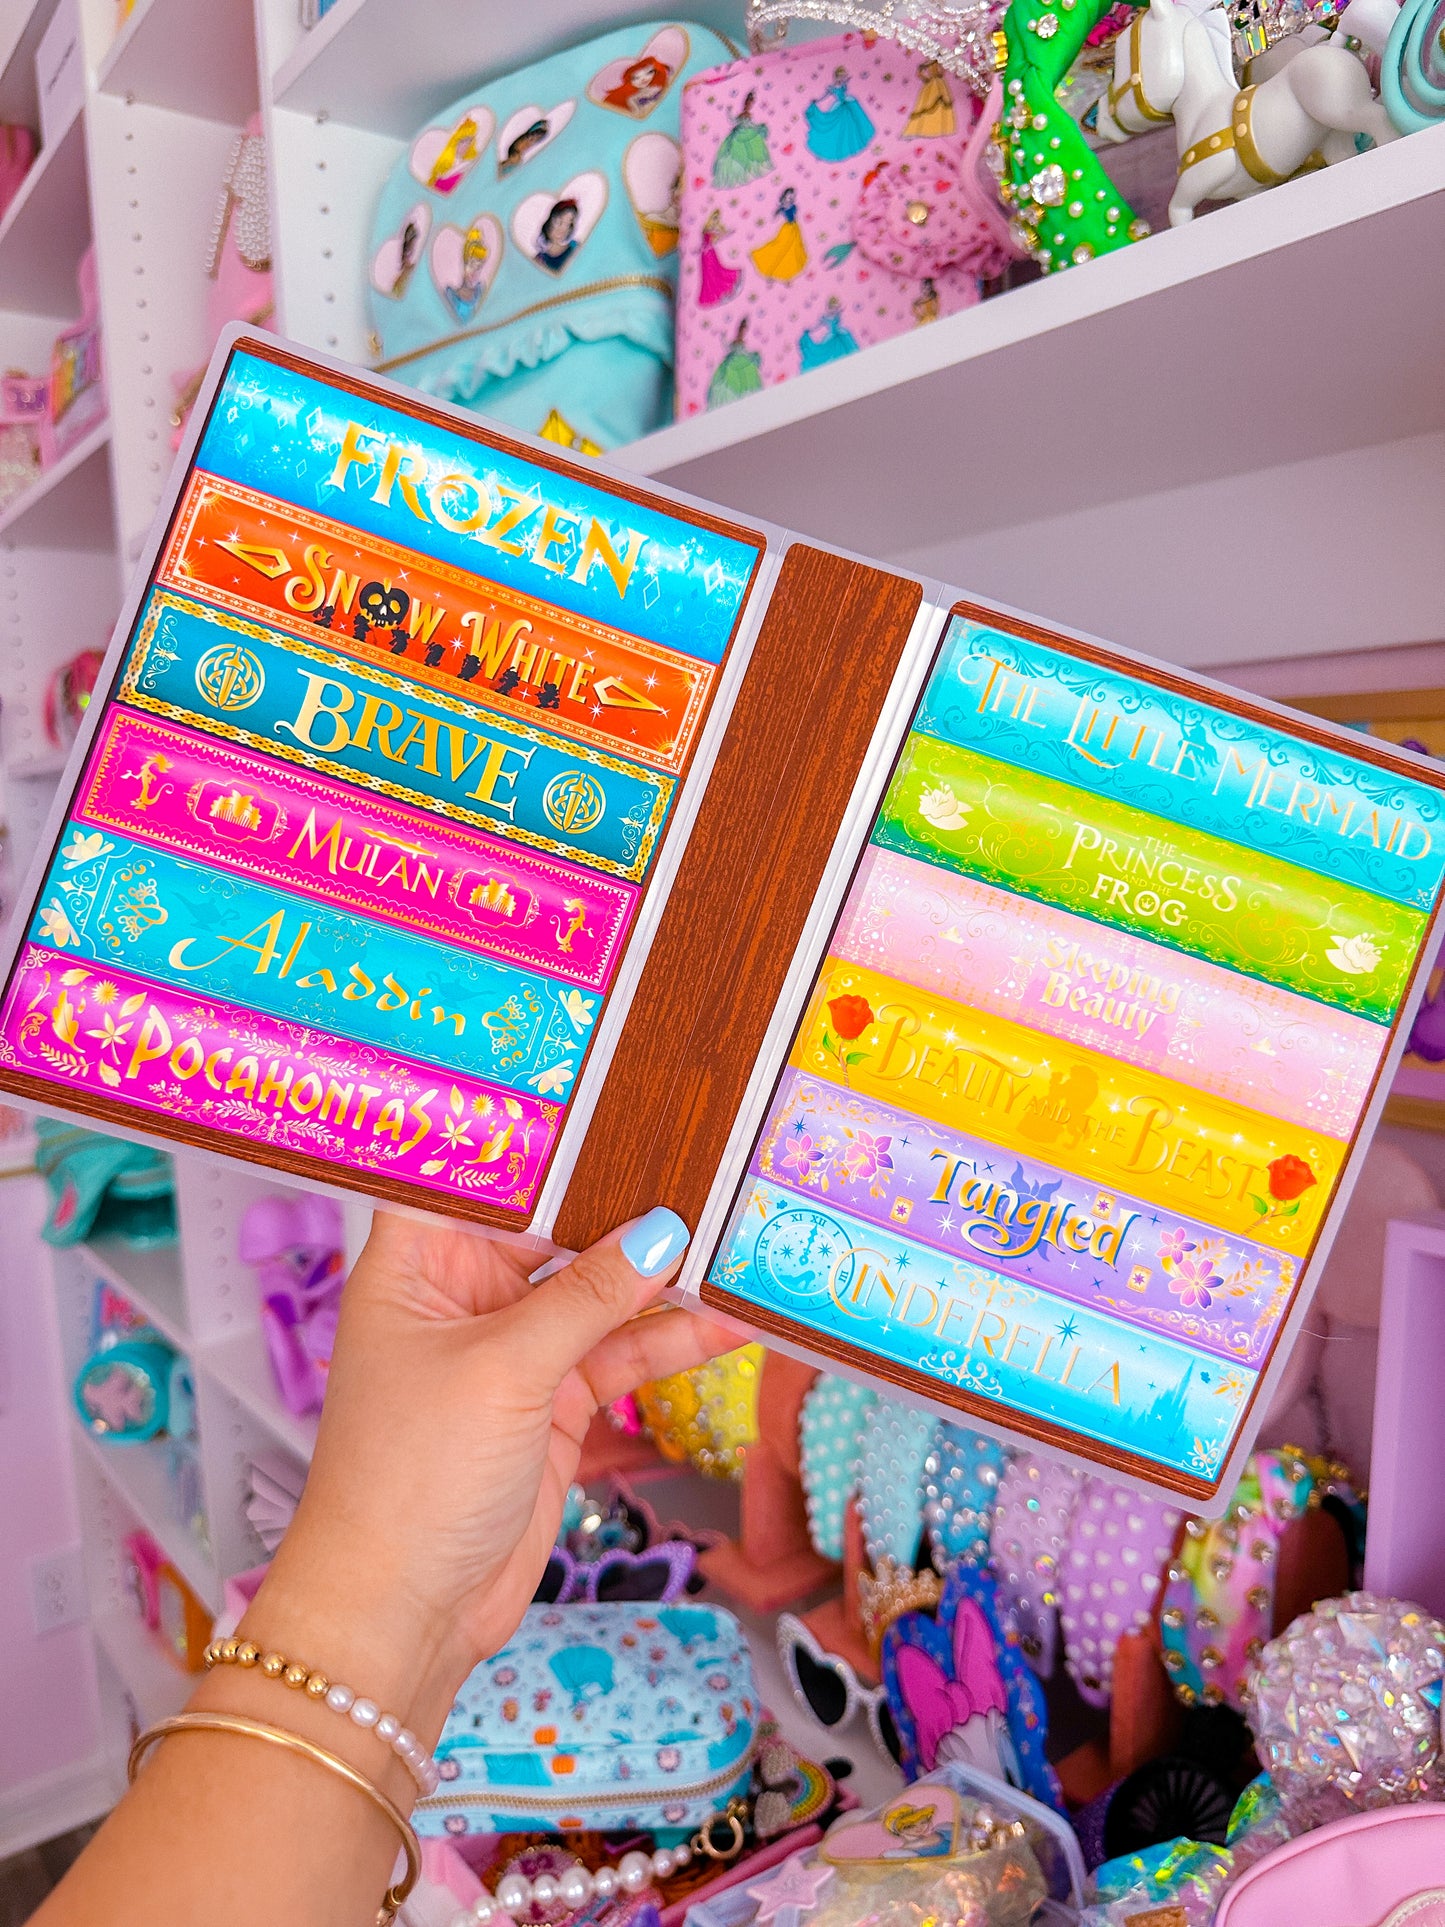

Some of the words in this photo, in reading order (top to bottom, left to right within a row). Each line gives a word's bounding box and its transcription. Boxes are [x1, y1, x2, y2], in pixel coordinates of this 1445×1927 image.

[324, 420, 650, 600] FROZEN
[460, 611, 601, 706] WHITE
[273, 668, 537, 820] BRAVE
[956, 653, 1047, 729] THE
[1063, 694, 1205, 783] LITTLE
[1211, 745, 1433, 862] MERMAID
[286, 806, 445, 901] MULAN
[1061, 821, 1242, 912] PRINCESS
[1120, 873, 1147, 889] AND
[1151, 882, 1173, 897] THE
[1143, 835, 1178, 858] THE
[1089, 872, 1189, 927] FROG
[167, 908, 468, 1038] Aladdin
[1039, 969, 1159, 1041] Beauty
[1040, 936, 1183, 1015] Sleeping
[861, 1002, 1034, 1116] BEAUTY
[1022, 1094, 1072, 1126] AND
[1081, 1113, 1128, 1150] THE
[1112, 1095, 1268, 1202] BEAST
[927, 1146, 1143, 1273] Tangled
[827, 1245, 1122, 1406] CINDERELLA
